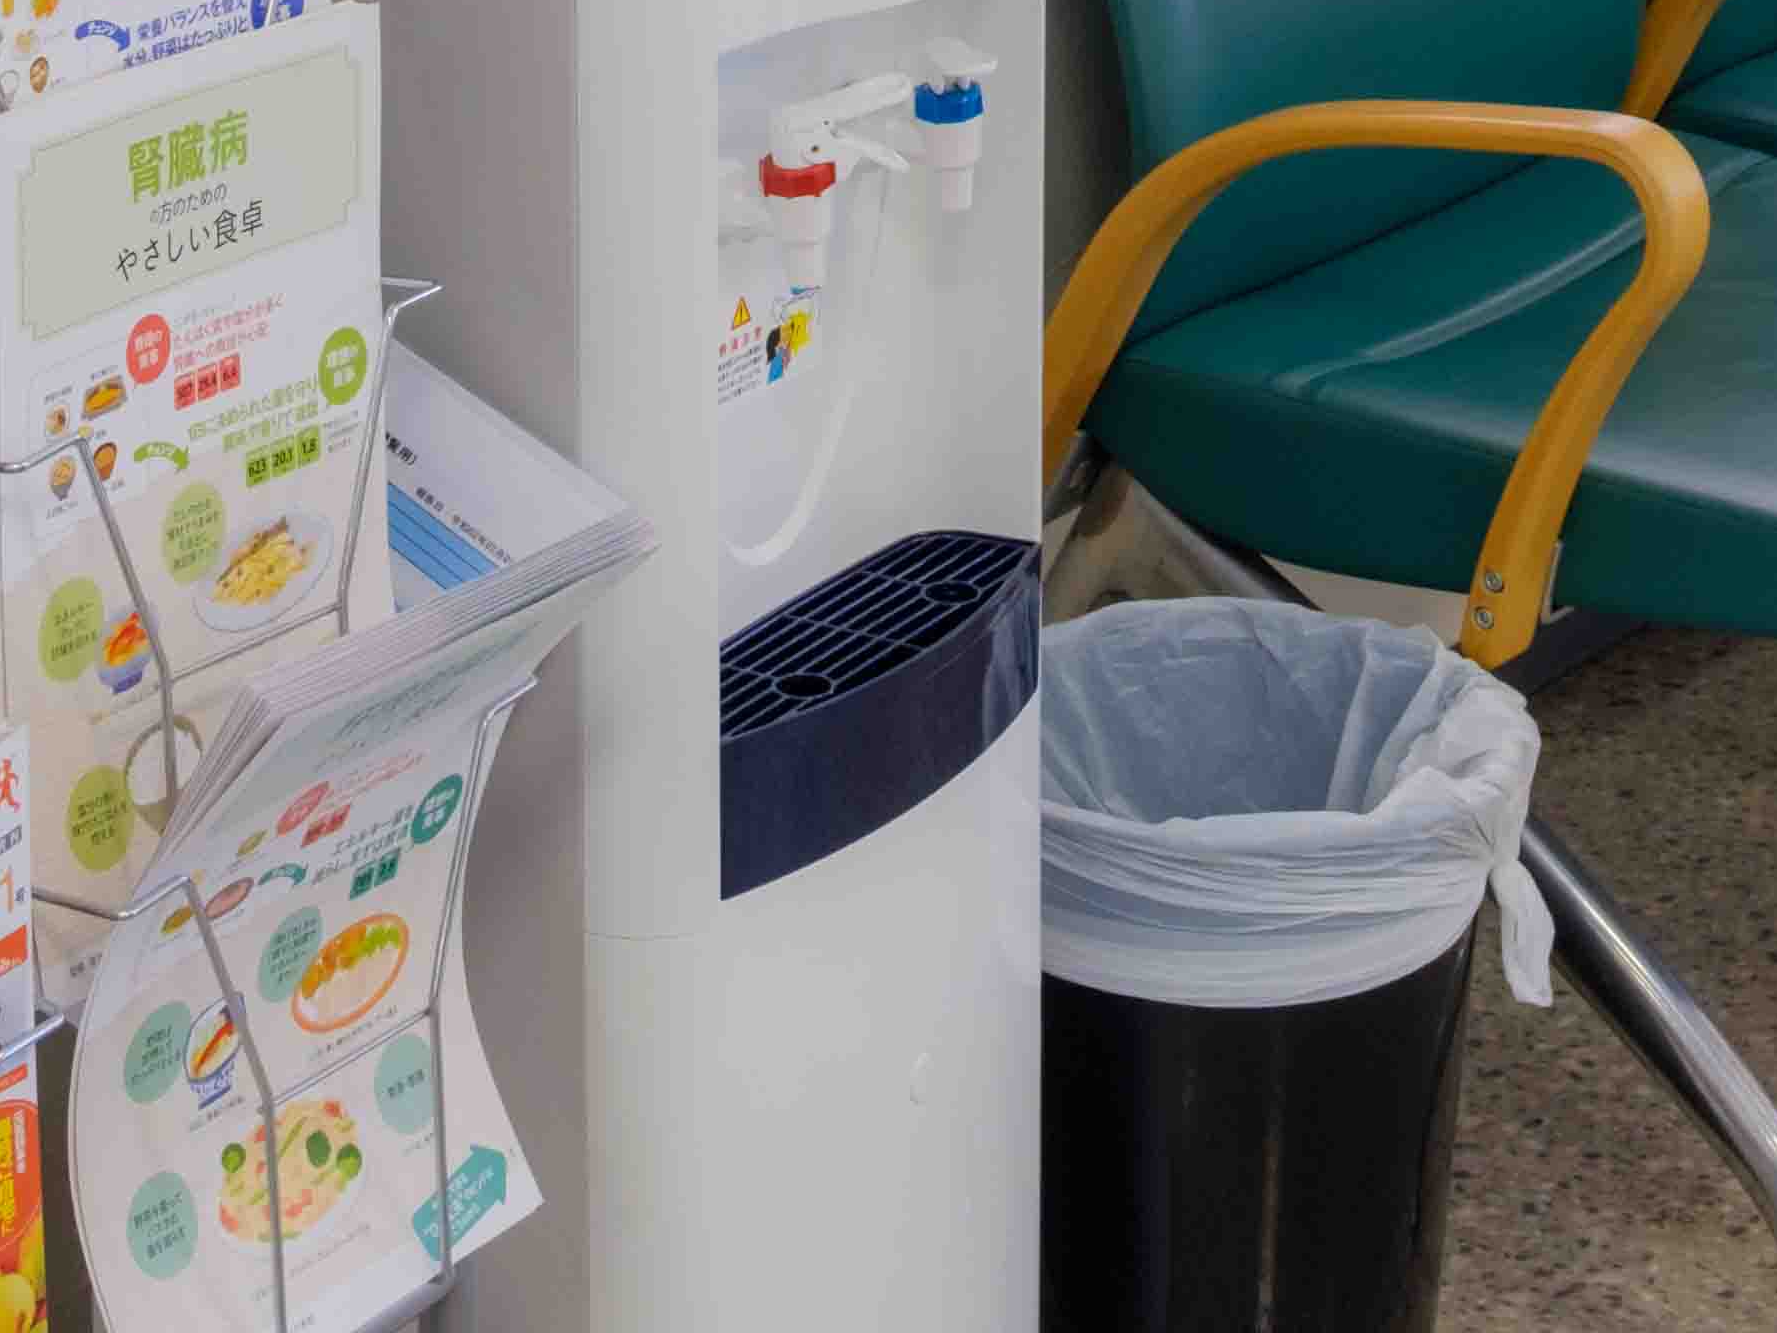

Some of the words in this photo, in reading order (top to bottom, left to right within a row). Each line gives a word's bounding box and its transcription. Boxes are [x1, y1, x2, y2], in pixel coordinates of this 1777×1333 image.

[127, 109, 248, 203] 腎臓病
[117, 200, 264, 281] やさしい食卓
[149, 183, 227, 225] の方のための
